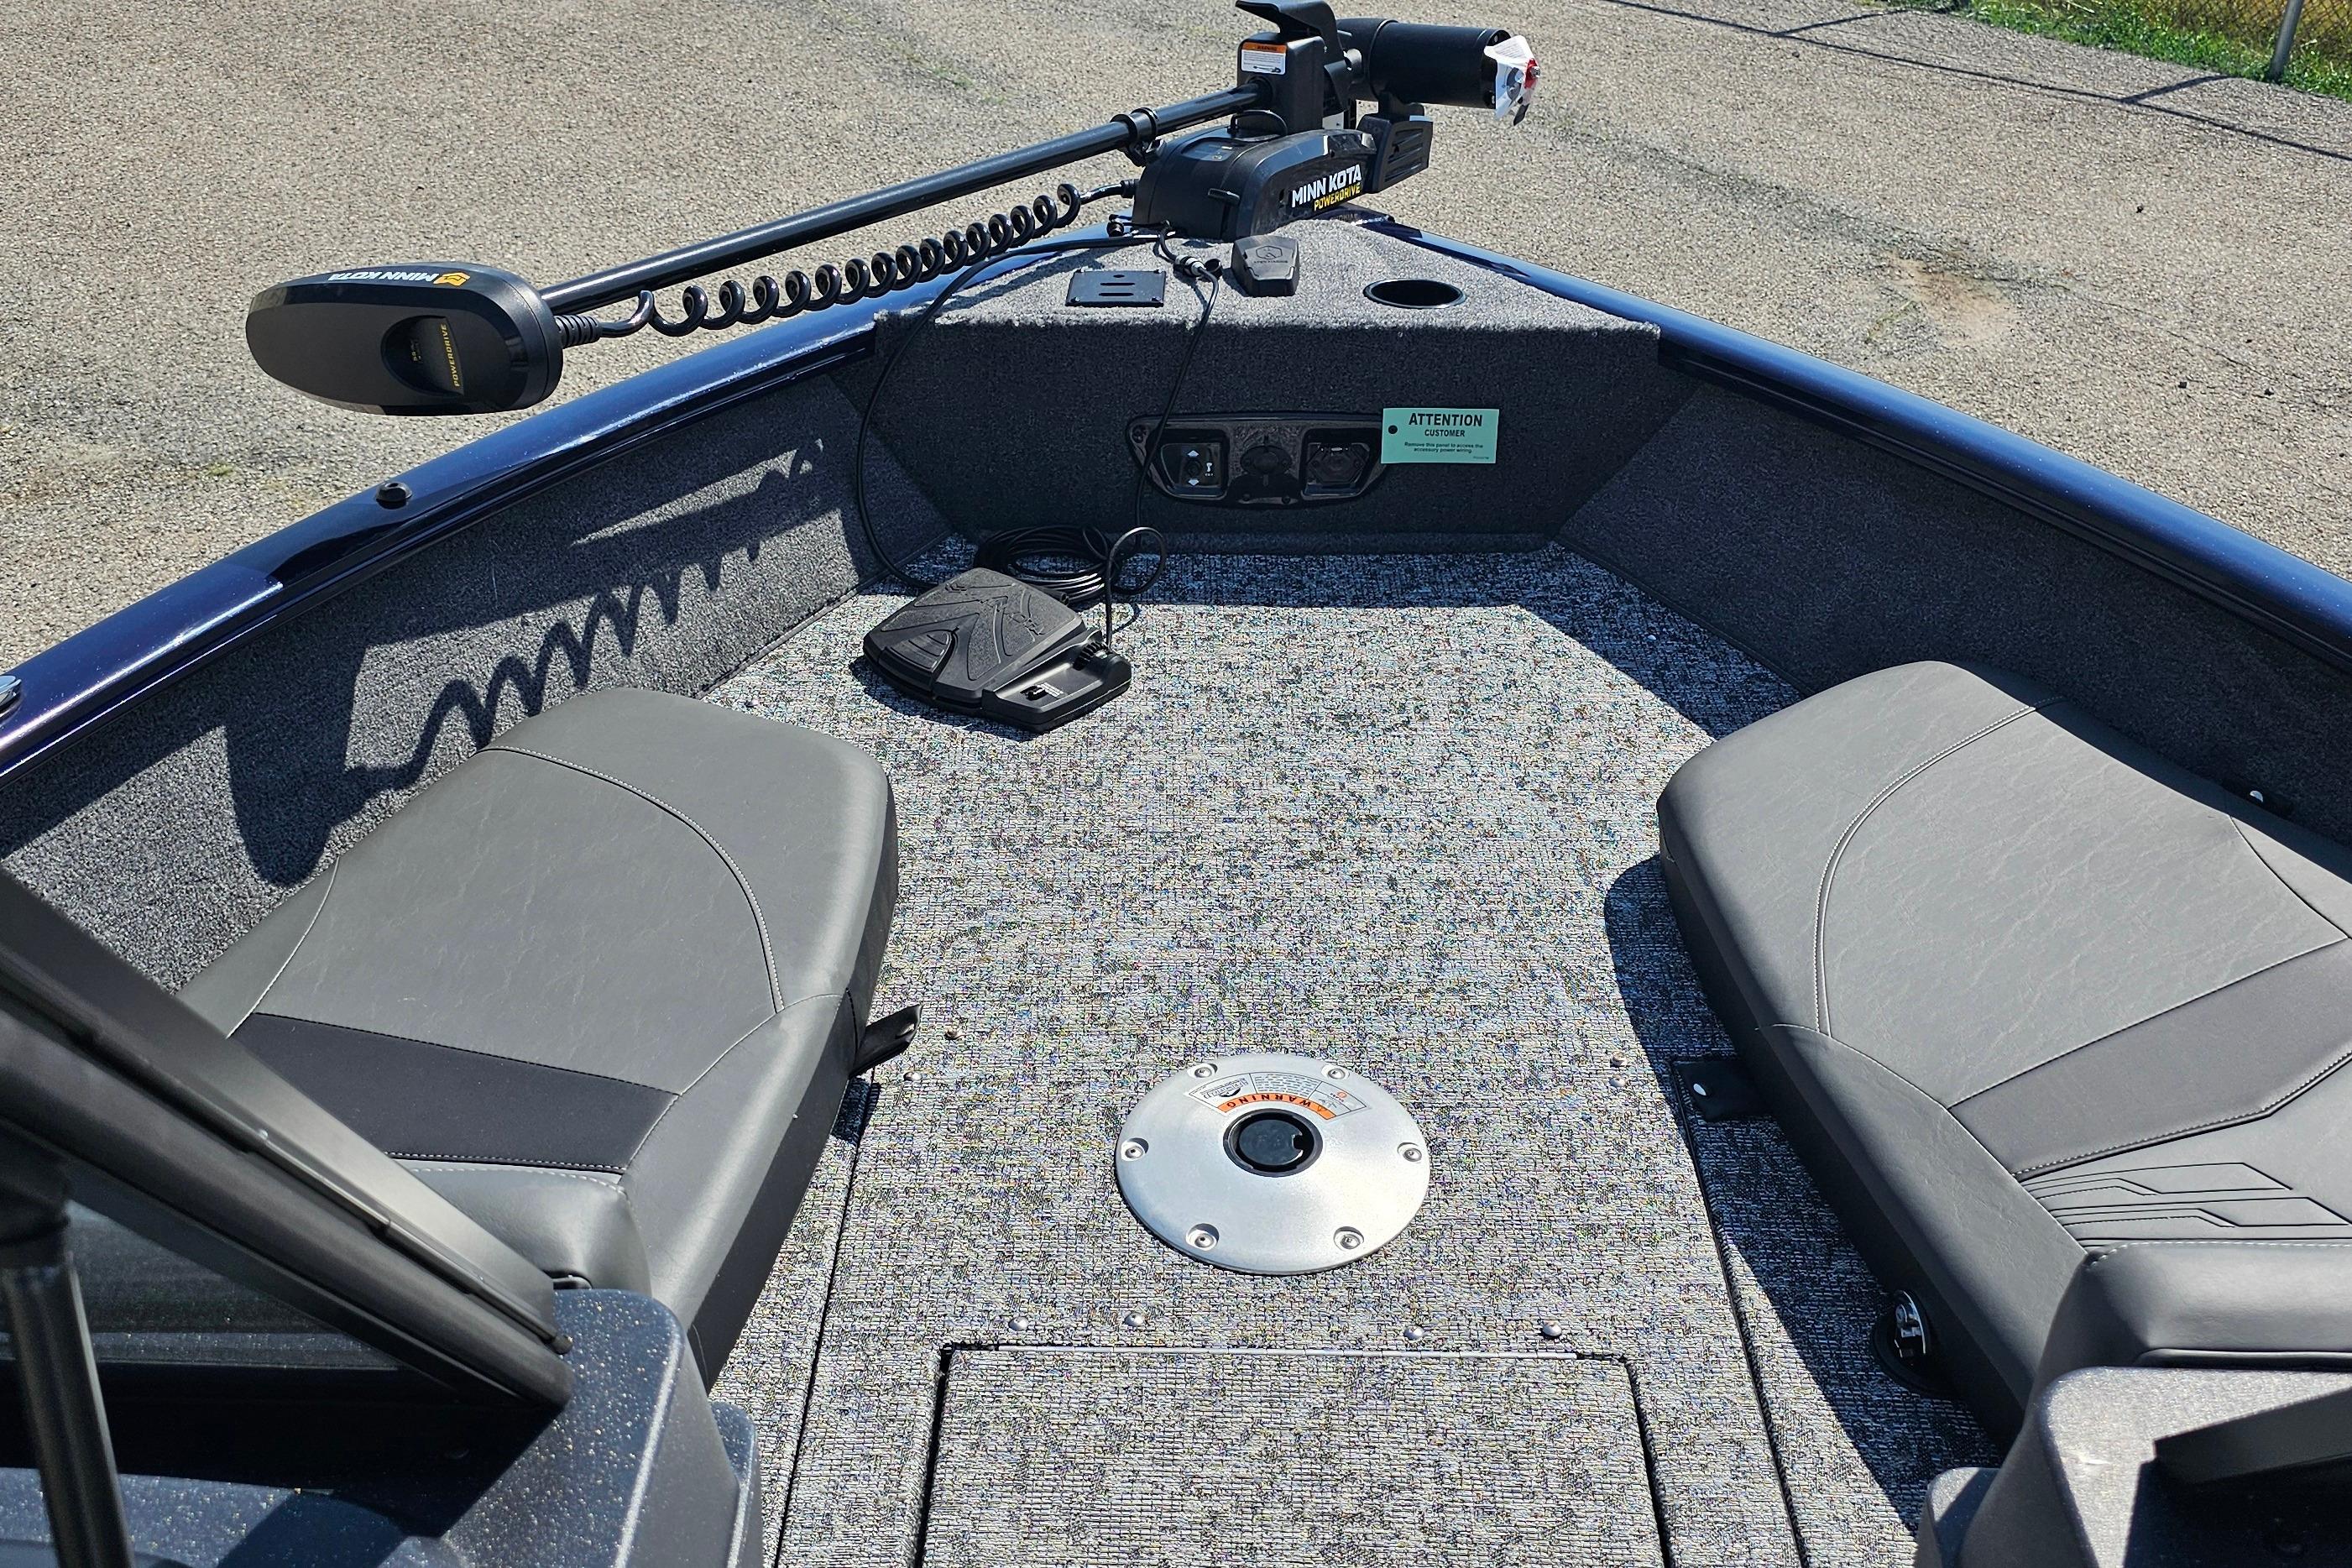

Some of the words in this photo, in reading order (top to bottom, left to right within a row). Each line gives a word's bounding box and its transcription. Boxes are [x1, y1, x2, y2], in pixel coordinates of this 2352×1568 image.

[1292, 178, 1326, 208] MINN
[1329, 164, 1362, 193] KOTA
[1314, 182, 1361, 212] POWERDRIVE
[328, 271, 379, 281] KOTA
[379, 271, 439, 282] MINN
[440, 323, 461, 387] POWERDRIVE
[1409, 412, 1483, 426] ATTENTION
[1424, 429, 1466, 437] CUSTOMER
[1226, 1094, 1311, 1109] WARNING
